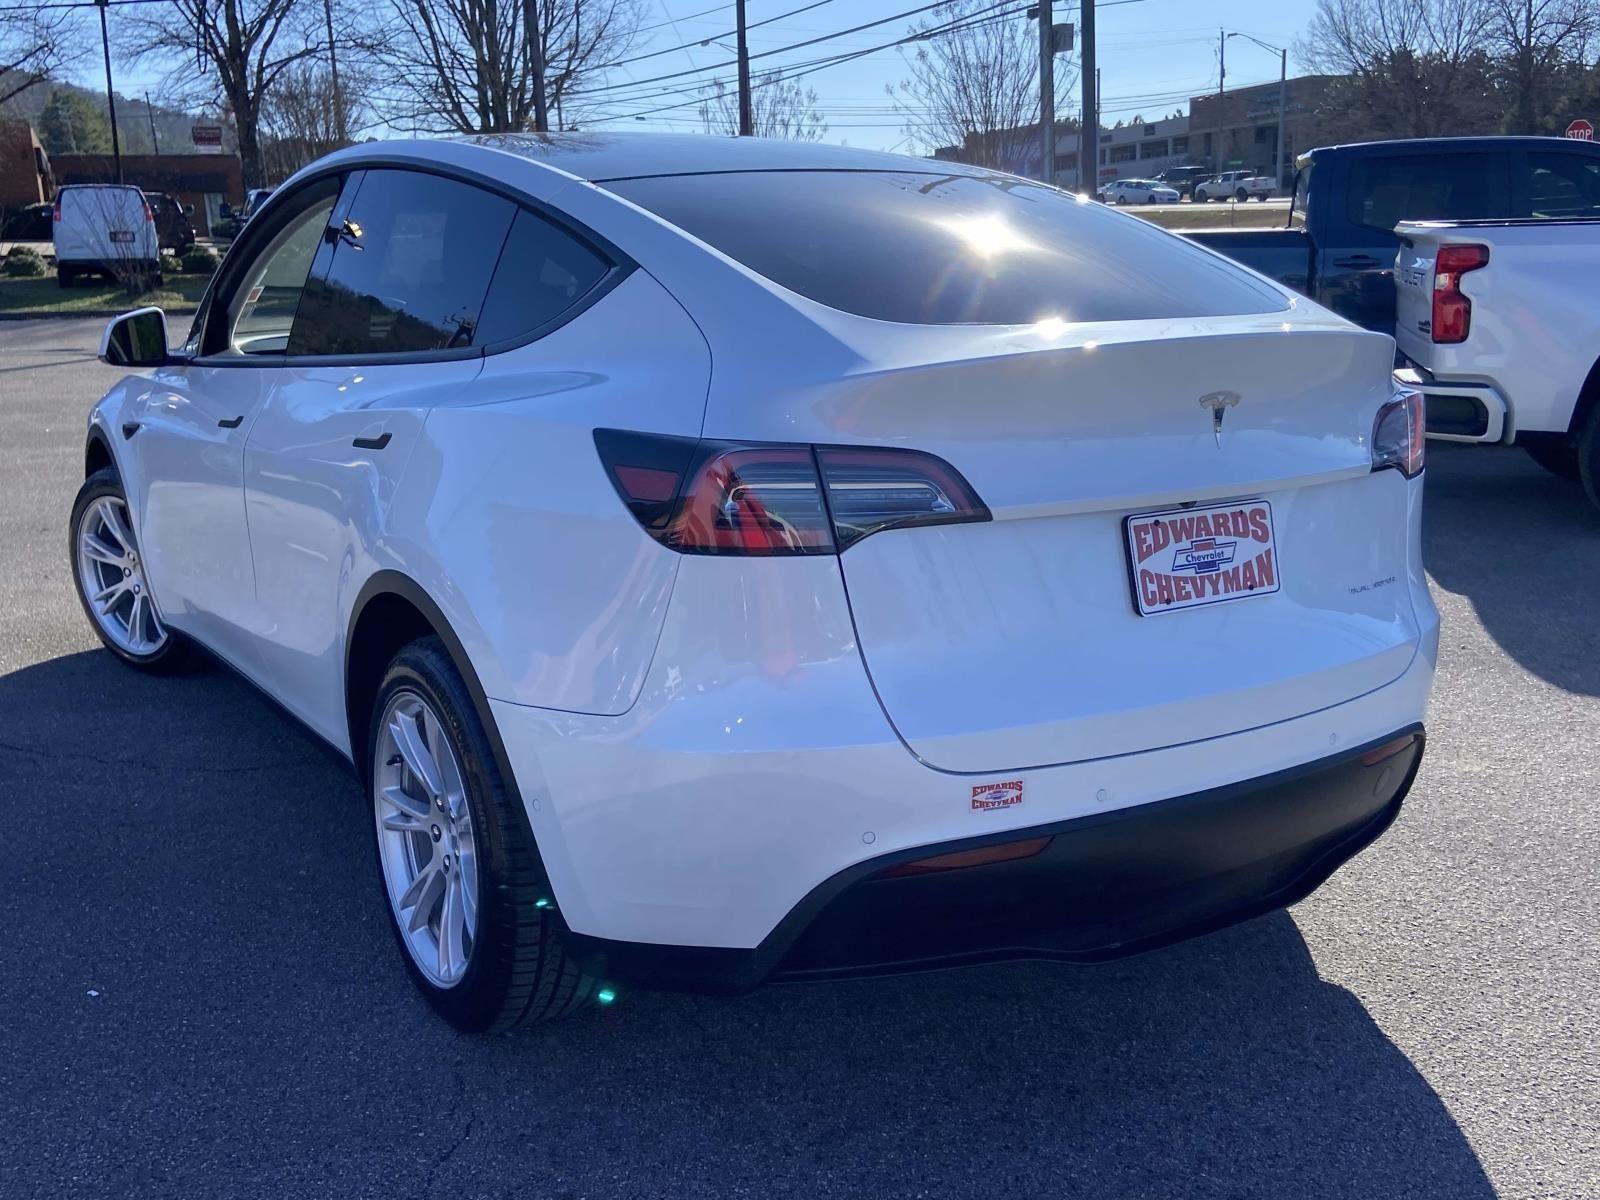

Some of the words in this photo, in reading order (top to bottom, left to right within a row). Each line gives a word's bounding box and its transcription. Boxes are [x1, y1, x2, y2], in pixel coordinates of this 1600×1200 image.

[1568, 130, 1591, 140] STOP
[1133, 508, 1270, 565] EDWARDS
[1185, 550, 1225, 563] Chevrolet
[1140, 548, 1275, 607] CHEVYMAN
[972, 780, 1023, 797] EDWARDS
[971, 793, 1023, 809] CHEVYMAN
